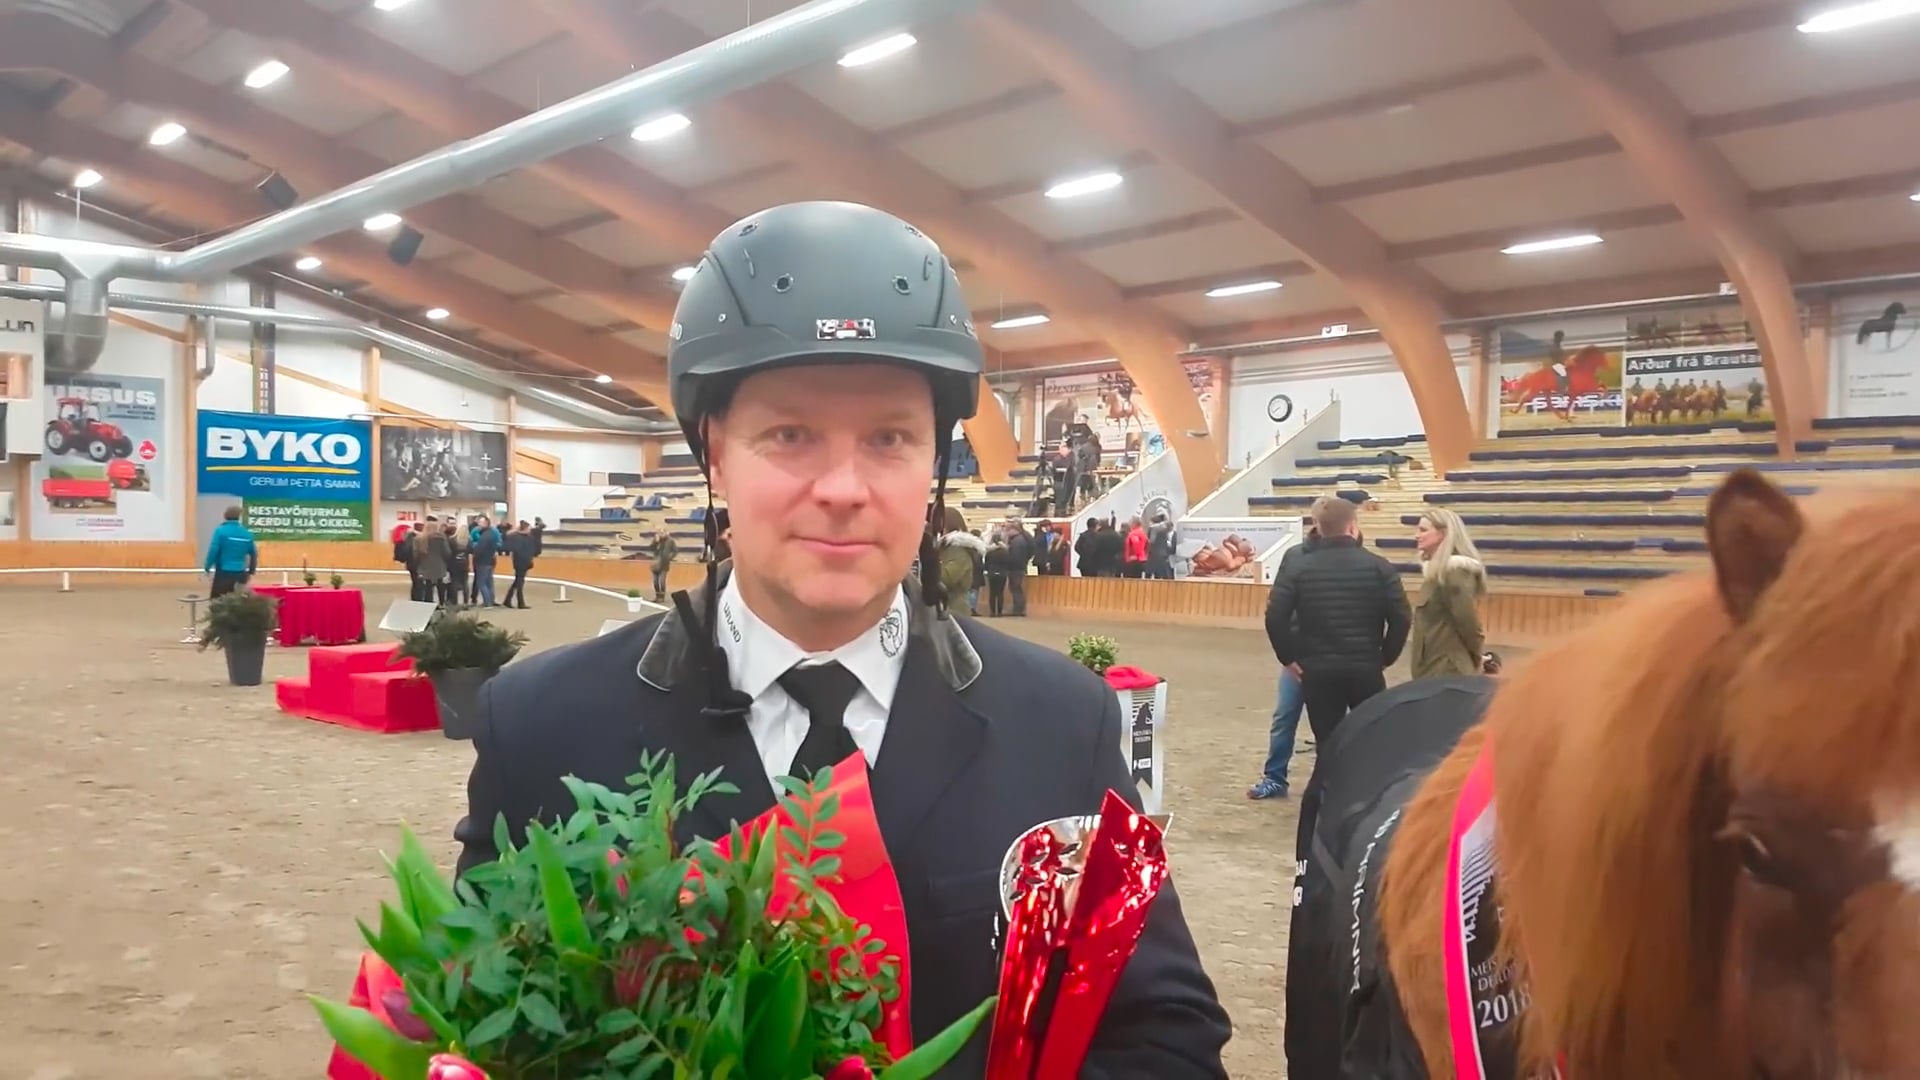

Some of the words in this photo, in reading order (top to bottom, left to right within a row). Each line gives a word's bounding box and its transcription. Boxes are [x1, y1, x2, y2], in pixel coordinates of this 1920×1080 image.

[1676, 355, 1699, 368] frá
[48, 384, 157, 405] URSUS
[206, 426, 362, 465] BYKO
[1477, 983, 1533, 1028] 2018
